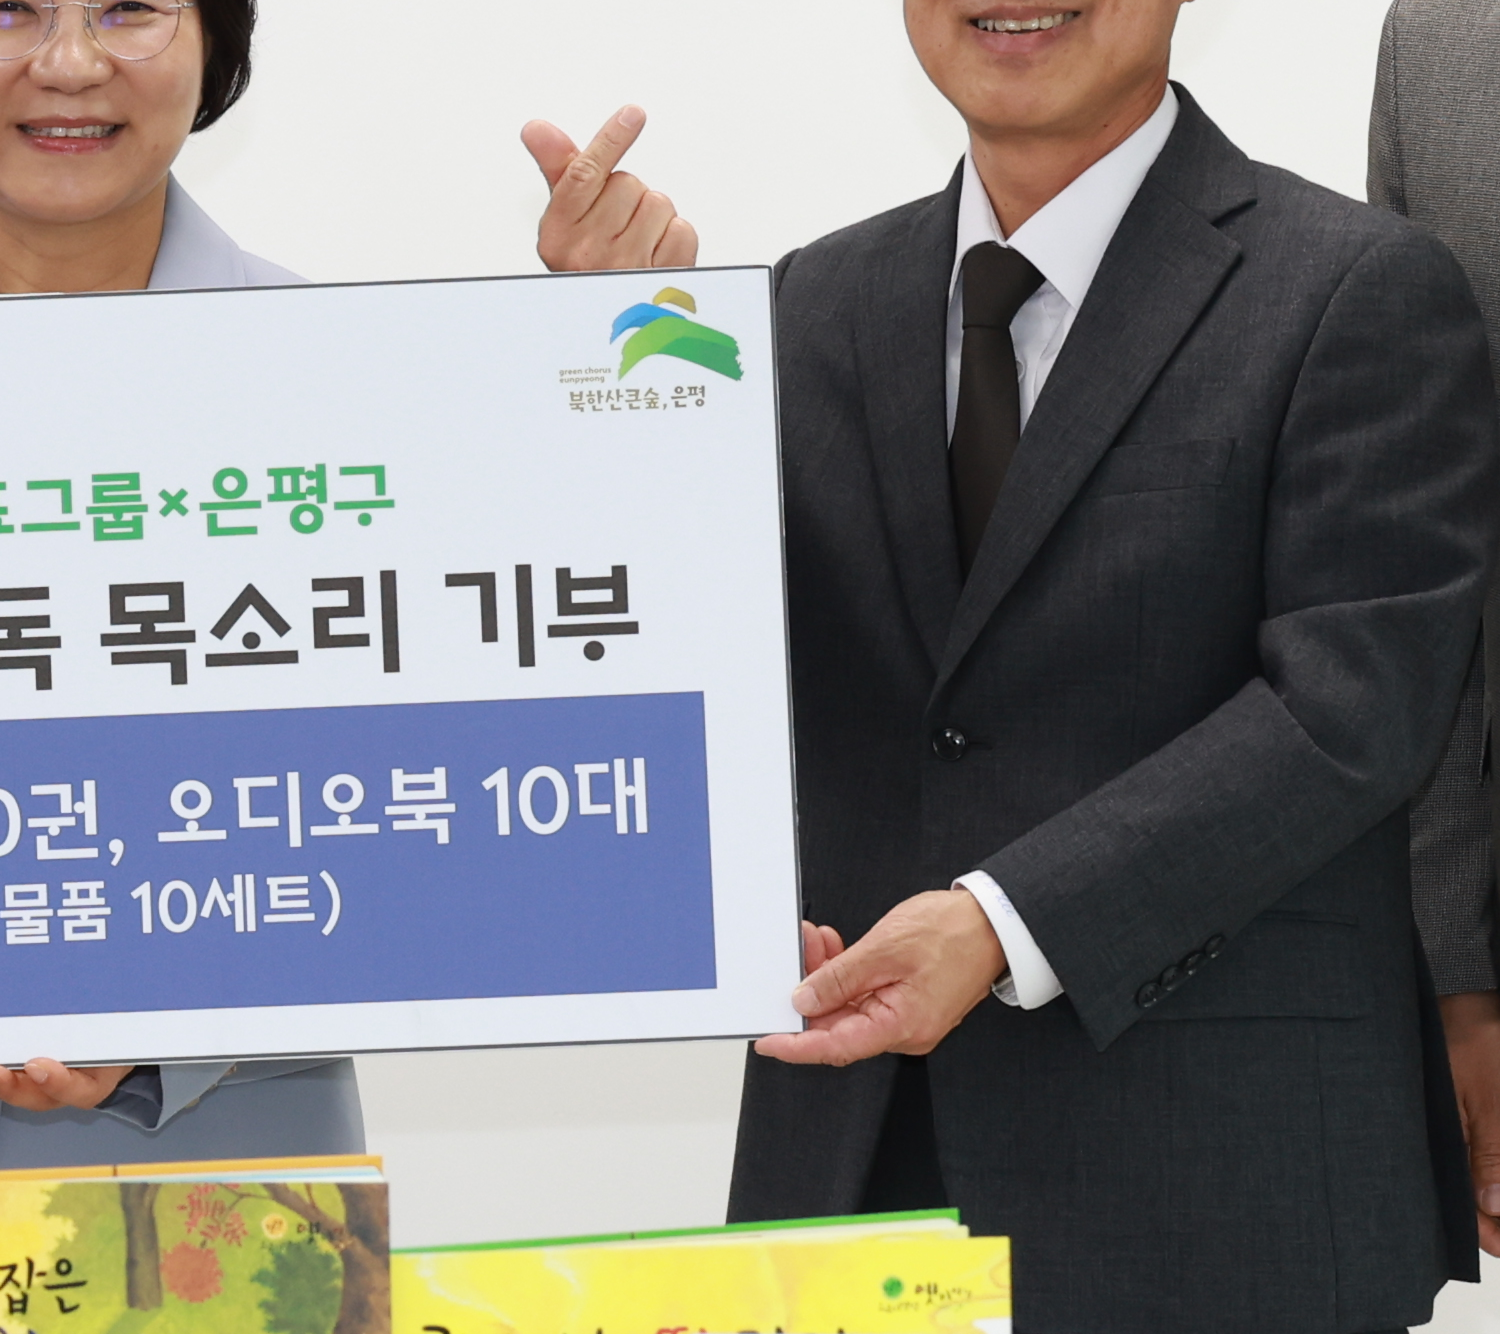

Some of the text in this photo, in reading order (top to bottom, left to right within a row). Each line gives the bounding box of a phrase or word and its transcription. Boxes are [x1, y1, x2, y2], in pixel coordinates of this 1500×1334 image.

[559, 366, 612, 377] green chorus
[559, 375, 605, 384] eunpyeong
[670, 385, 706, 409] 은평
[98, 569, 402, 686] 목소리
[443, 562, 641, 663] 기부
[156, 765, 457, 849] 오디오북
[480, 756, 650, 837] 10대
[129, 870, 342, 937] 10세트)
